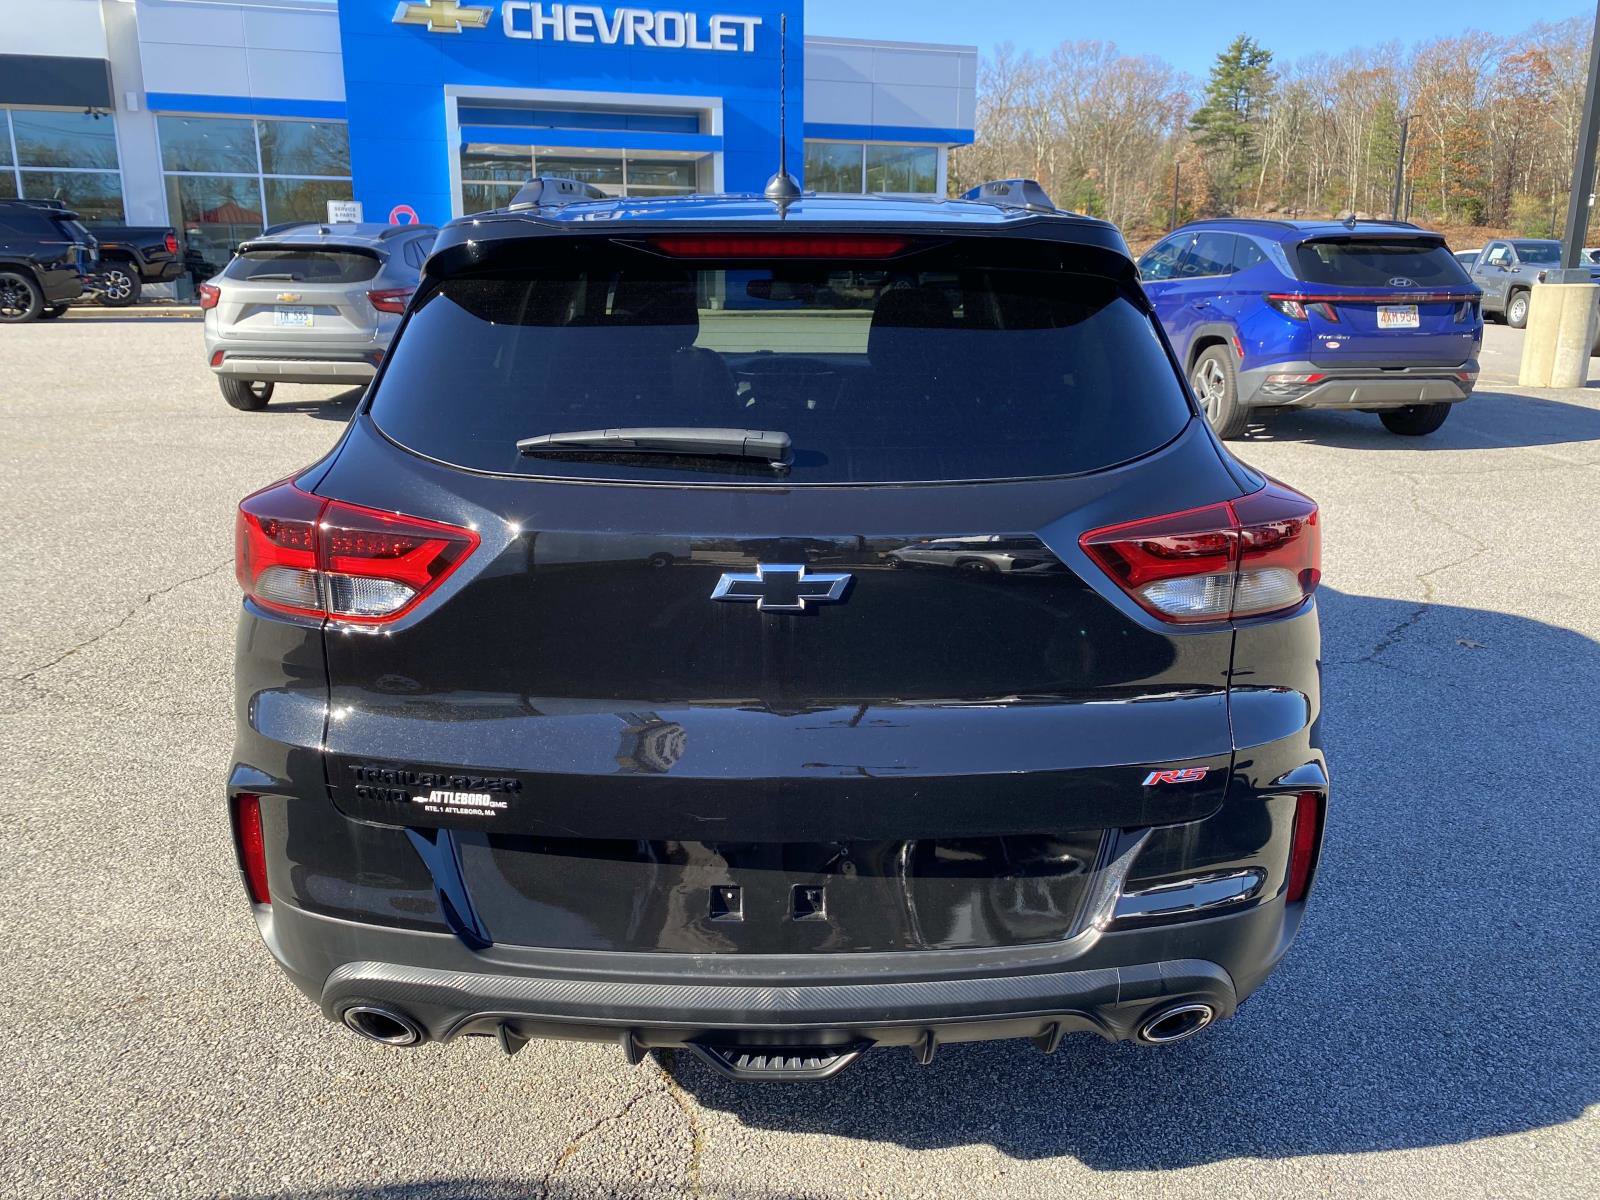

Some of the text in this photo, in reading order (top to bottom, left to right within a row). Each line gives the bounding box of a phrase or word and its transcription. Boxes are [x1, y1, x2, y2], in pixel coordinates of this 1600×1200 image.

[501, 0, 762, 52] CHEVROLET
[348, 764, 523, 794] TRAILBLAZER
[1142, 766, 1210, 786] RS
[429, 790, 508, 809] ATTLEBORO GMC
[445, 807, 484, 816] ATTLEBORO,
